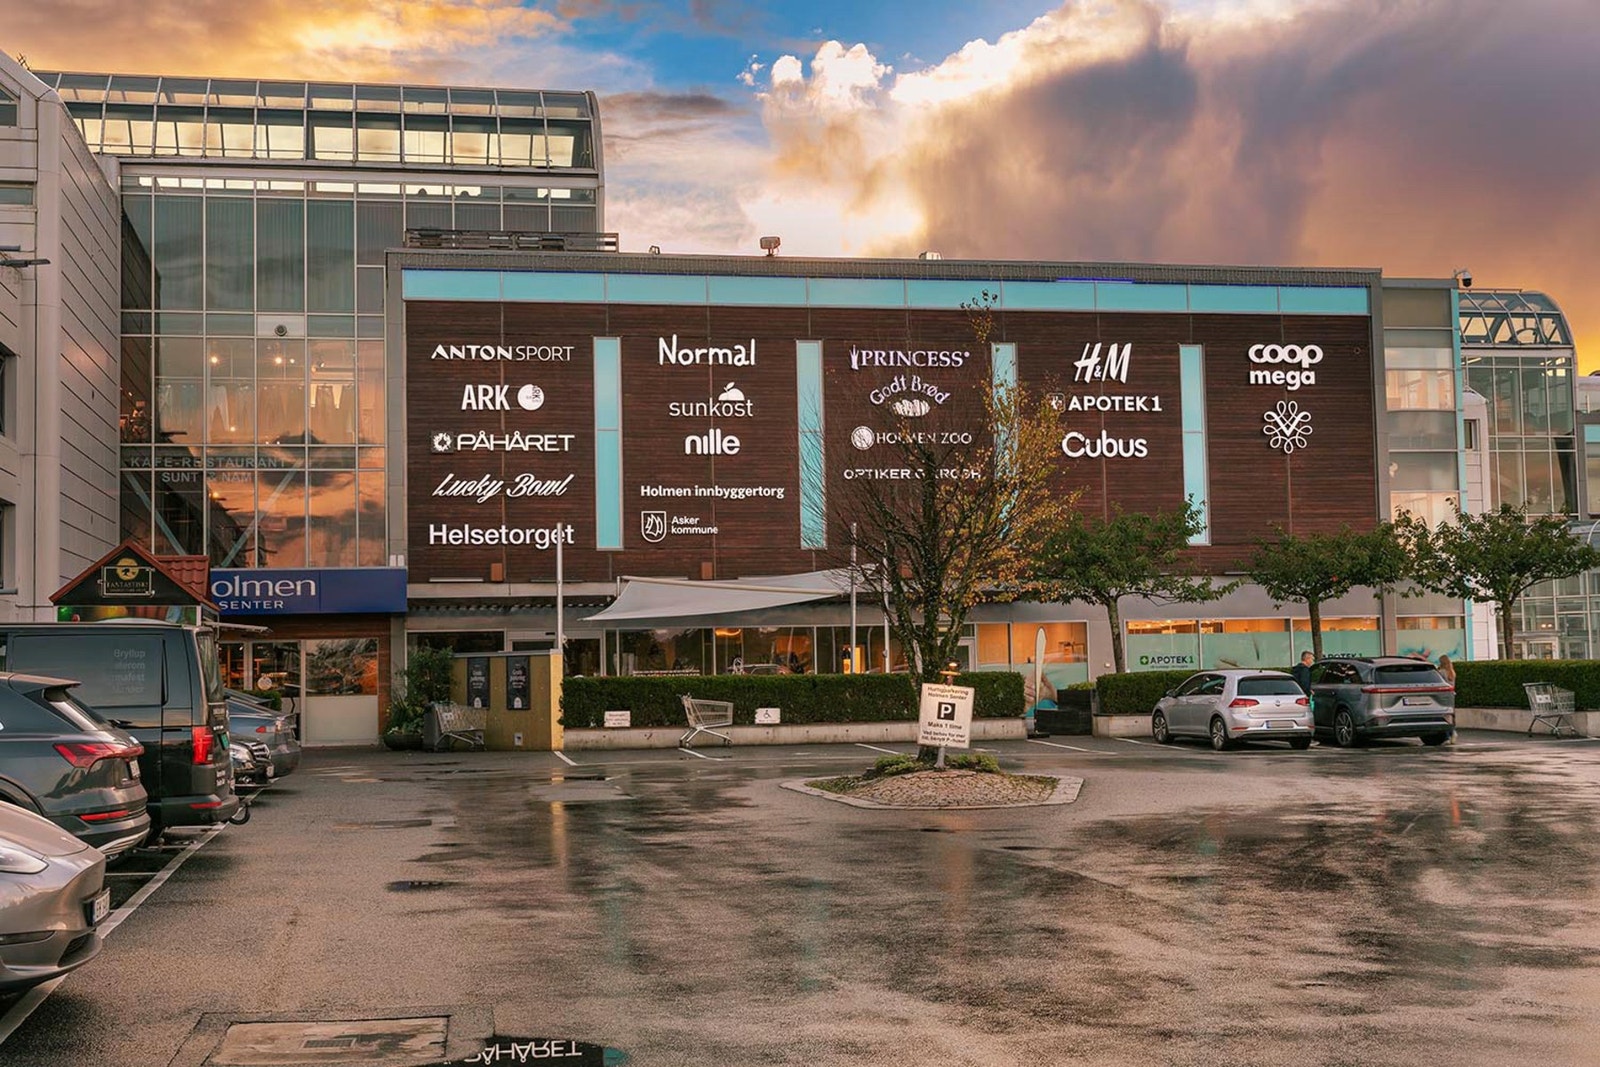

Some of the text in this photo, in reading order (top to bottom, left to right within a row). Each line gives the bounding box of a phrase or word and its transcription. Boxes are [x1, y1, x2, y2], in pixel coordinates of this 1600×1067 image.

[658, 334, 756, 366] Normal
[1248, 344, 1323, 368] coop
[1073, 342, 1132, 384] H&M
[869, 374, 951, 405] Godt Brød
[1249, 369, 1316, 391] mega
[461, 384, 511, 411] ARK
[669, 397, 754, 417] sunkost
[1068, 396, 1162, 412] APOTEK 1
[456, 430, 575, 451] PÅHÅRET
[684, 428, 741, 455] nille
[940, 432, 973, 444] ZOO
[1061, 430, 1149, 458] Cubus
[161, 472, 198, 483] SUNT
[843, 468, 911, 480] OPTIKER
[432, 473, 575, 503] Lucky Bowl
[641, 485, 785, 499] Holmen innbyggertorg
[671, 516, 699, 525] Asker
[671, 526, 718, 535] kommune
[429, 524, 575, 549] Helsetorget
[218, 600, 285, 611] SENTER
[1150, 655, 1195, 664] APOTEK 1
[940, 704, 952, 718] P
